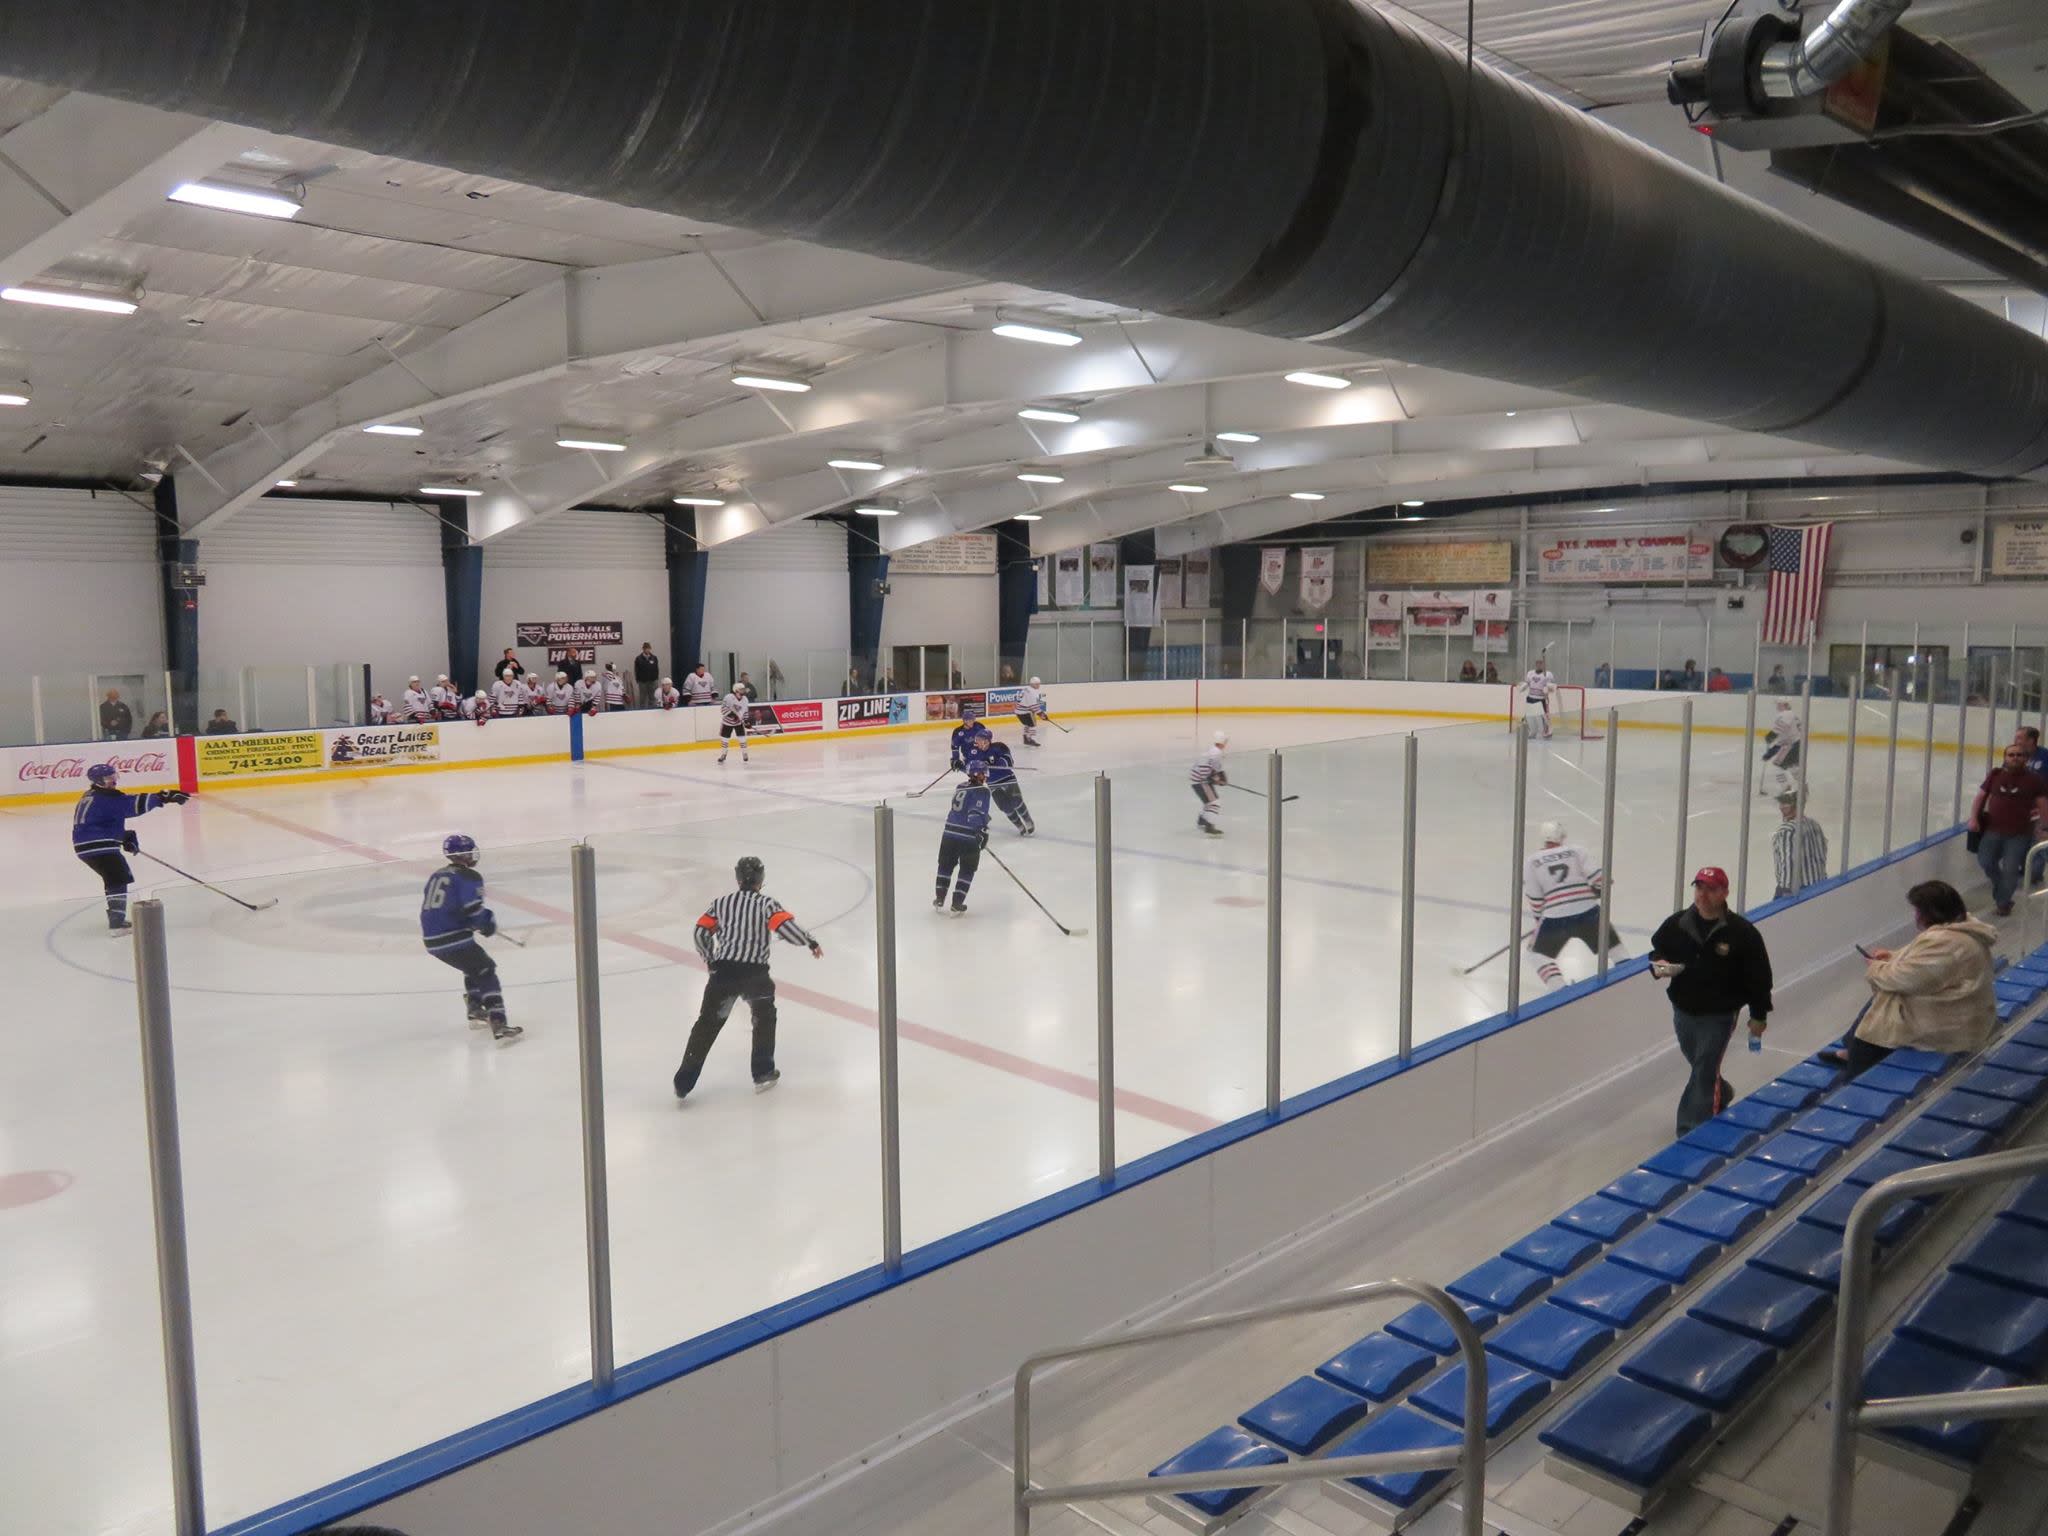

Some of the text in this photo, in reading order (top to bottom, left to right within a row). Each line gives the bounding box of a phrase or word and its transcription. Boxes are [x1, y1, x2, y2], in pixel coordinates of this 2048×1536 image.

[548, 631, 621, 641] POWERHAWKS
[839, 697, 891, 721] ZIP LINE
[204, 741, 228, 749] AAA
[357, 733, 396, 746] GREAT
[206, 748, 240, 756] CHIMNEY
[246, 745, 286, 753] FIREPLACE
[361, 743, 428, 757] REAL ESTATE
[229, 755, 303, 770] 741-2400
[1547, 863, 1570, 883] 7
[423, 876, 451, 910] 16
